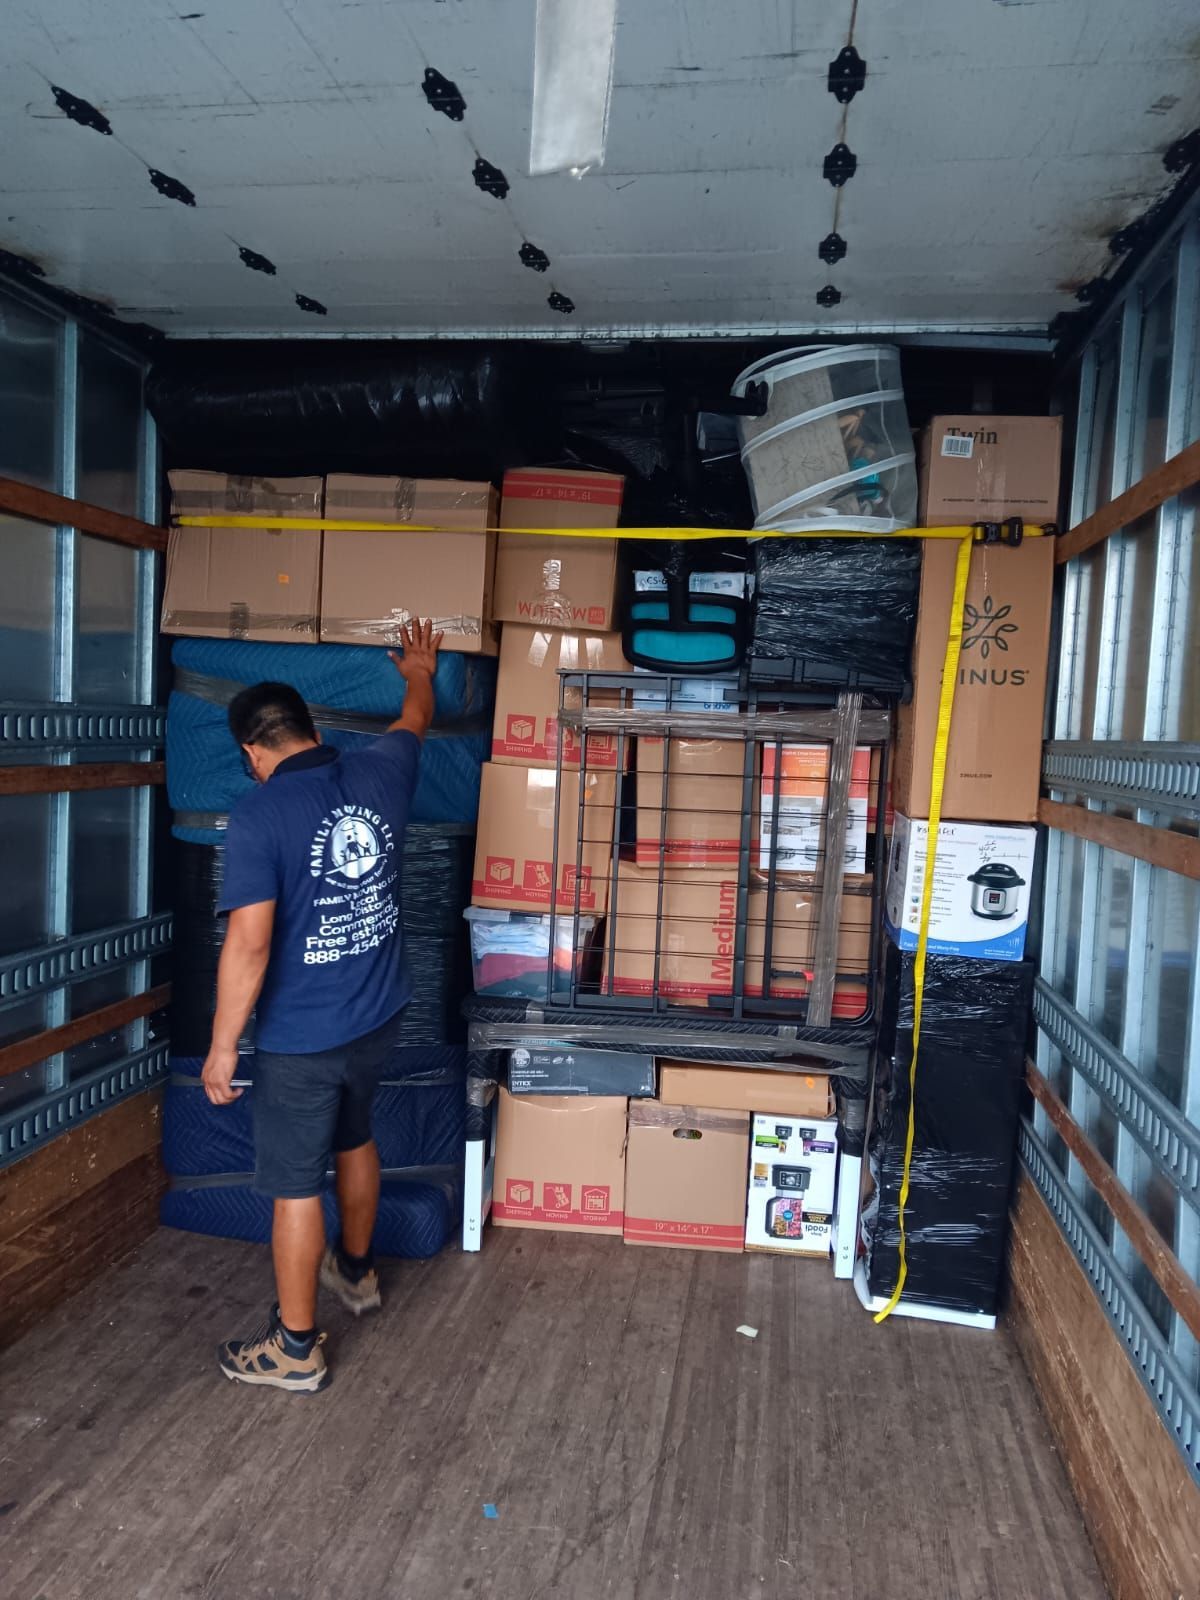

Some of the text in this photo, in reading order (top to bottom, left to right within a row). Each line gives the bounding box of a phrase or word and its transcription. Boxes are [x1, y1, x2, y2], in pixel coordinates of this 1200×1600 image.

[940, 669, 1026, 686] INUS
[313, 893, 352, 907] FAMILY
[350, 892, 378, 910] Local
[321, 912, 353, 925] Long
[711, 880, 736, 982] Medium
[306, 936, 347, 949] Free
[505, 1208, 532, 1217] SHIPPING
[545, 1212, 569, 1220] MOVING
[655, 1222, 668, 1231] 19"
[677, 1224, 691, 1233] 14"
[701, 1226, 714, 1234] 17"
[805, 1224, 829, 1234] Foodi
